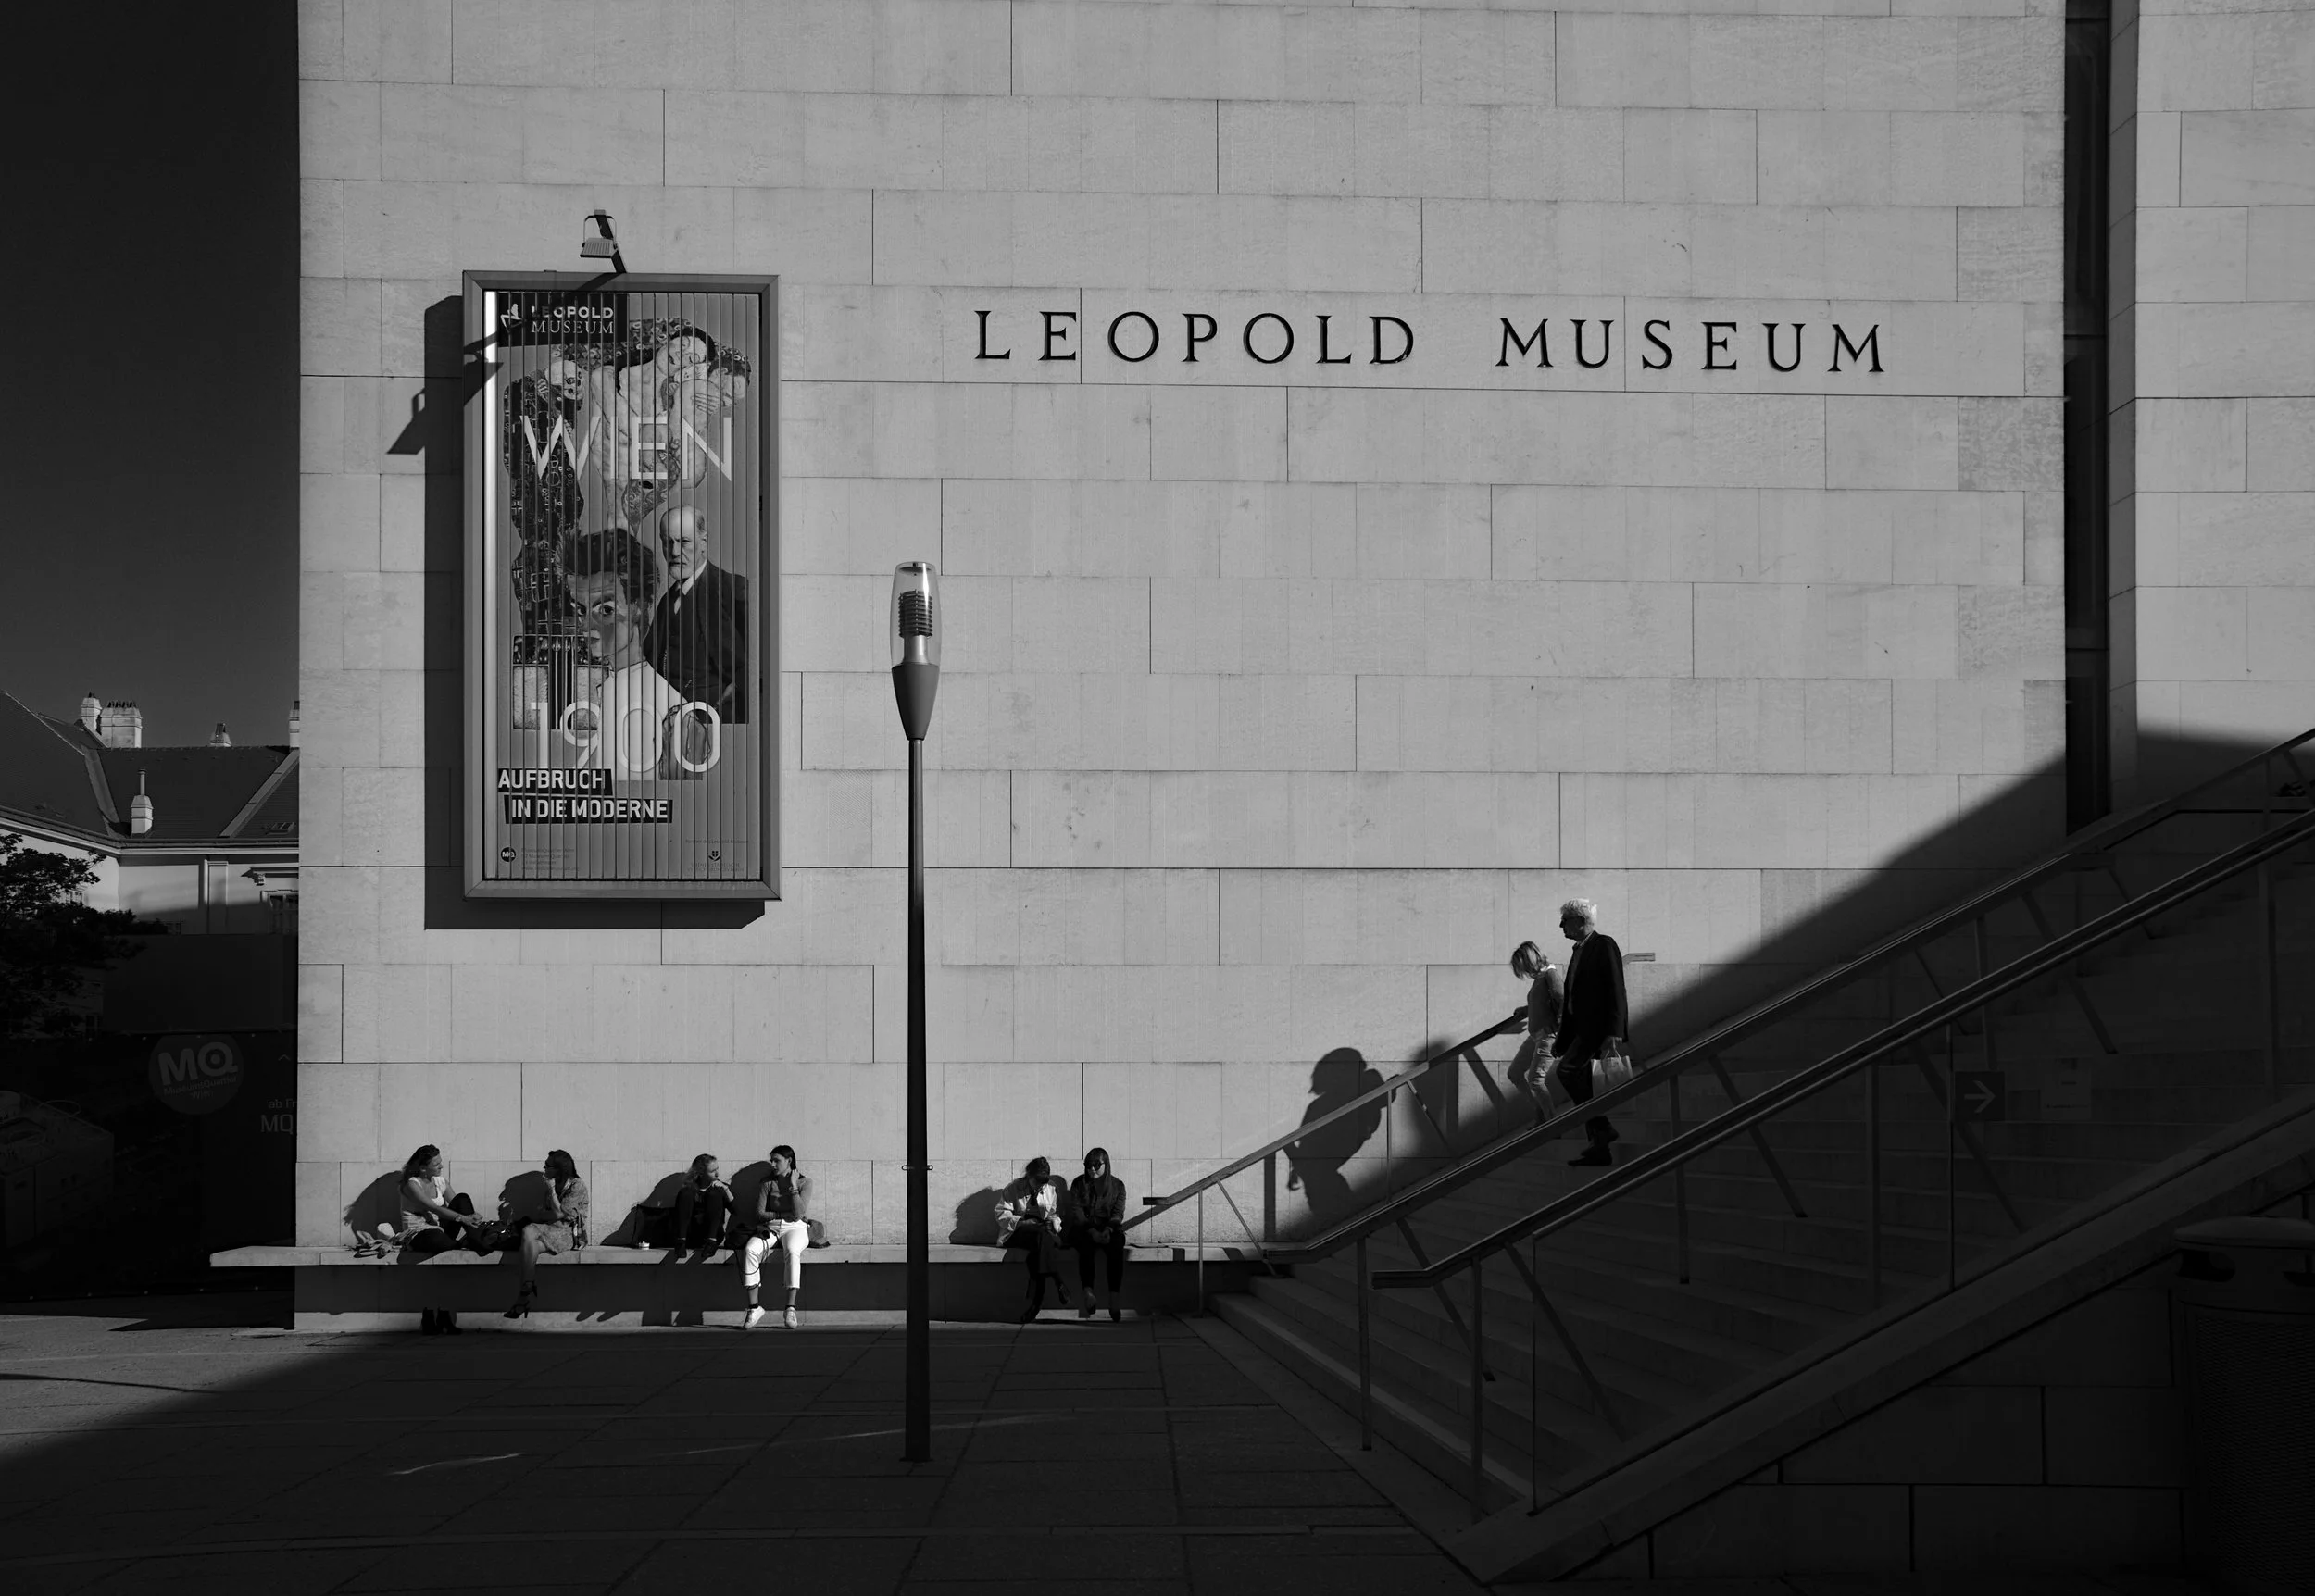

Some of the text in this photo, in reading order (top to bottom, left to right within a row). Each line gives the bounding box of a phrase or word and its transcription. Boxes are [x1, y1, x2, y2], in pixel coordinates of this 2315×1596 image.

[531, 305, 614, 319] LEOPOLD
[531, 320, 614, 334] MUSEUM
[974, 310, 1885, 373] LEOPOLD MUSEUM
[519, 415, 732, 482] WIEN
[531, 701, 720, 772] 1900
[498, 769, 605, 789] AUFBRUCH
[511, 799, 669, 818] IN DIE MODERNE
[157, 1041, 238, 1086] MQ
